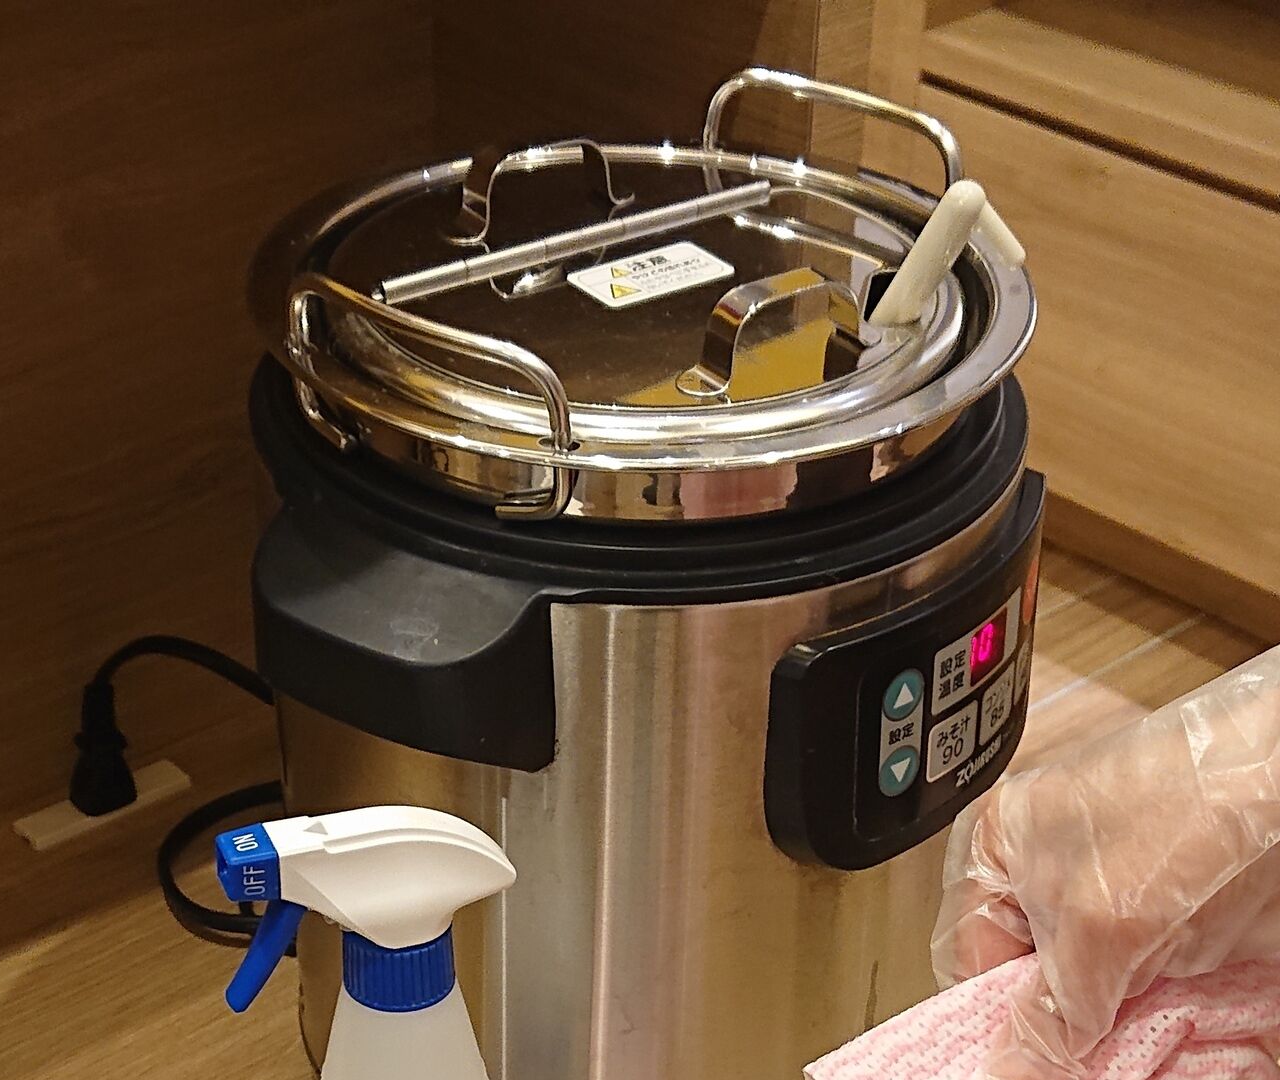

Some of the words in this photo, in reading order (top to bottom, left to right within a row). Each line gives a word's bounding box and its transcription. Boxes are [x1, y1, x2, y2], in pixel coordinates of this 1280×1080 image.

[939, 649, 967, 679] 設定
[938, 671, 965, 700] 温度
[888, 722, 915, 746] 設定
[936, 716, 971, 748] みそ汁
[942, 737, 964, 765] 90
[232, 833, 259, 852] ON
[243, 865, 266, 896] OFF
